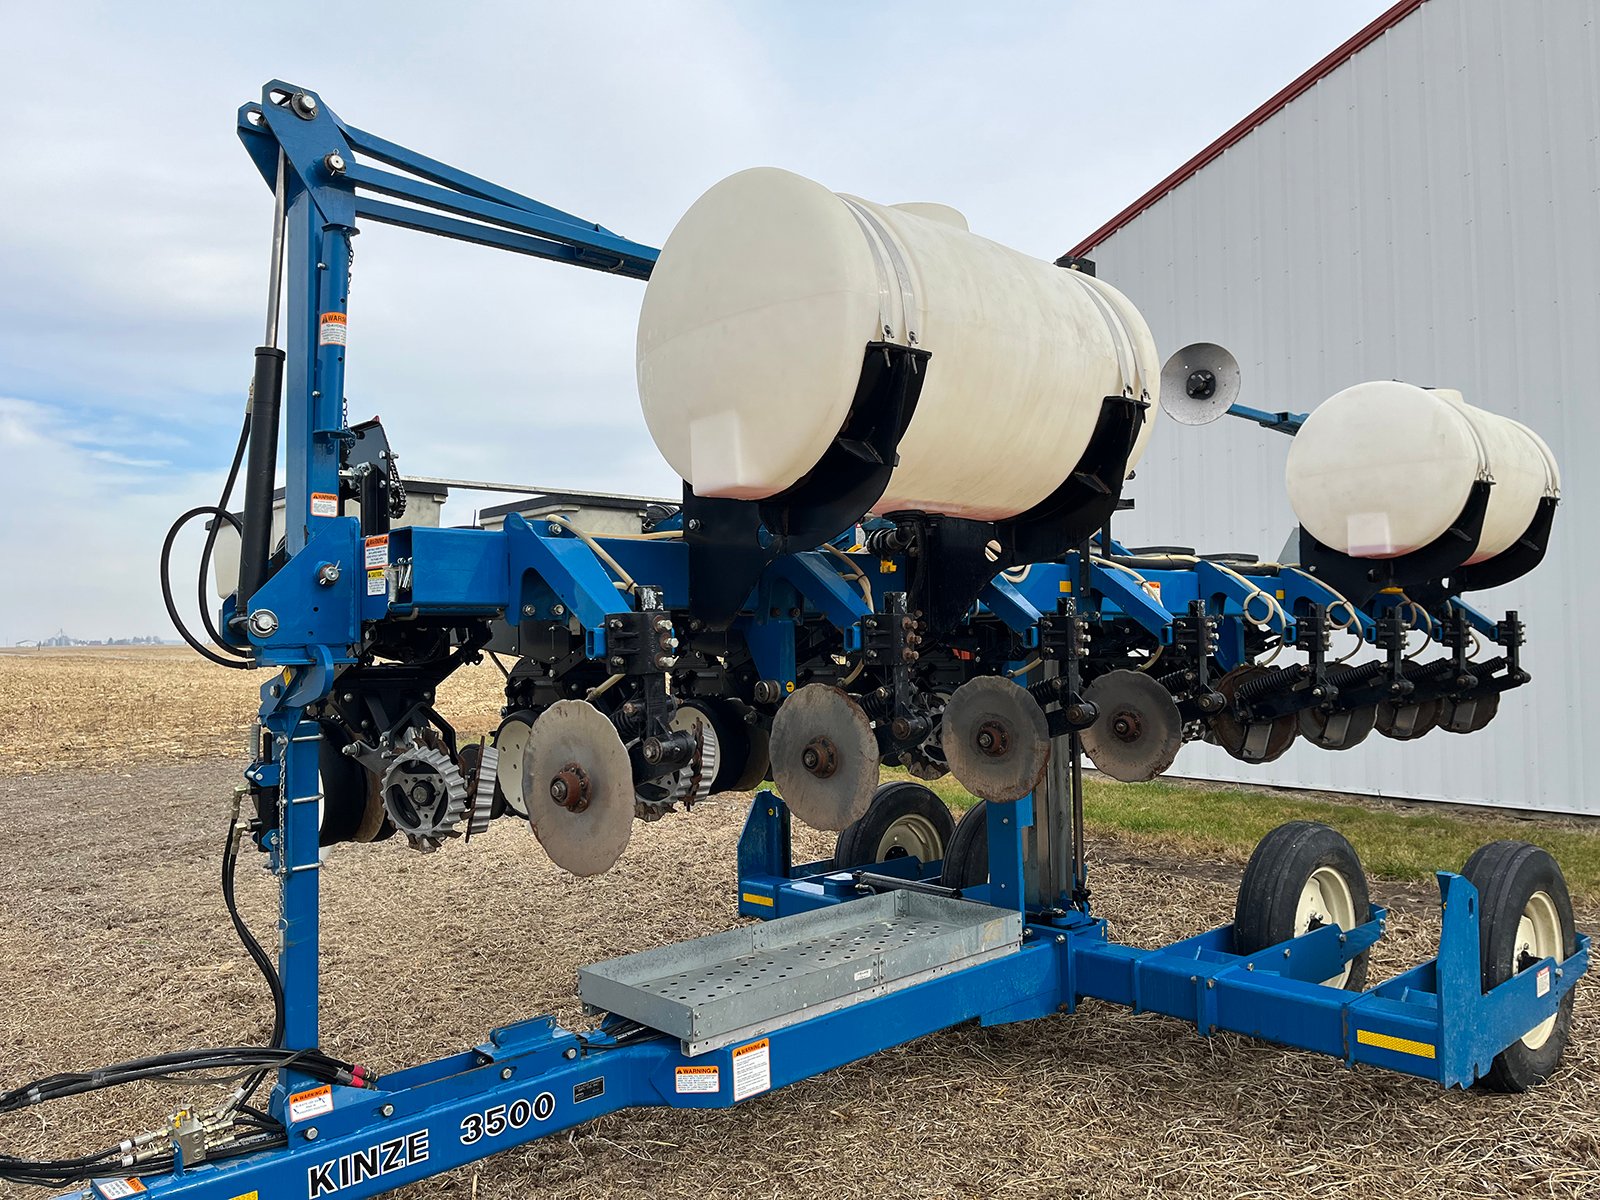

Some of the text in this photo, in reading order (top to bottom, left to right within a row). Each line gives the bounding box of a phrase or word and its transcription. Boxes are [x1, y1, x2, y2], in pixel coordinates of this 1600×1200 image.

[299, 1089, 323, 1101] WARNING
[308, 1091, 555, 1200] KINZE 3500
